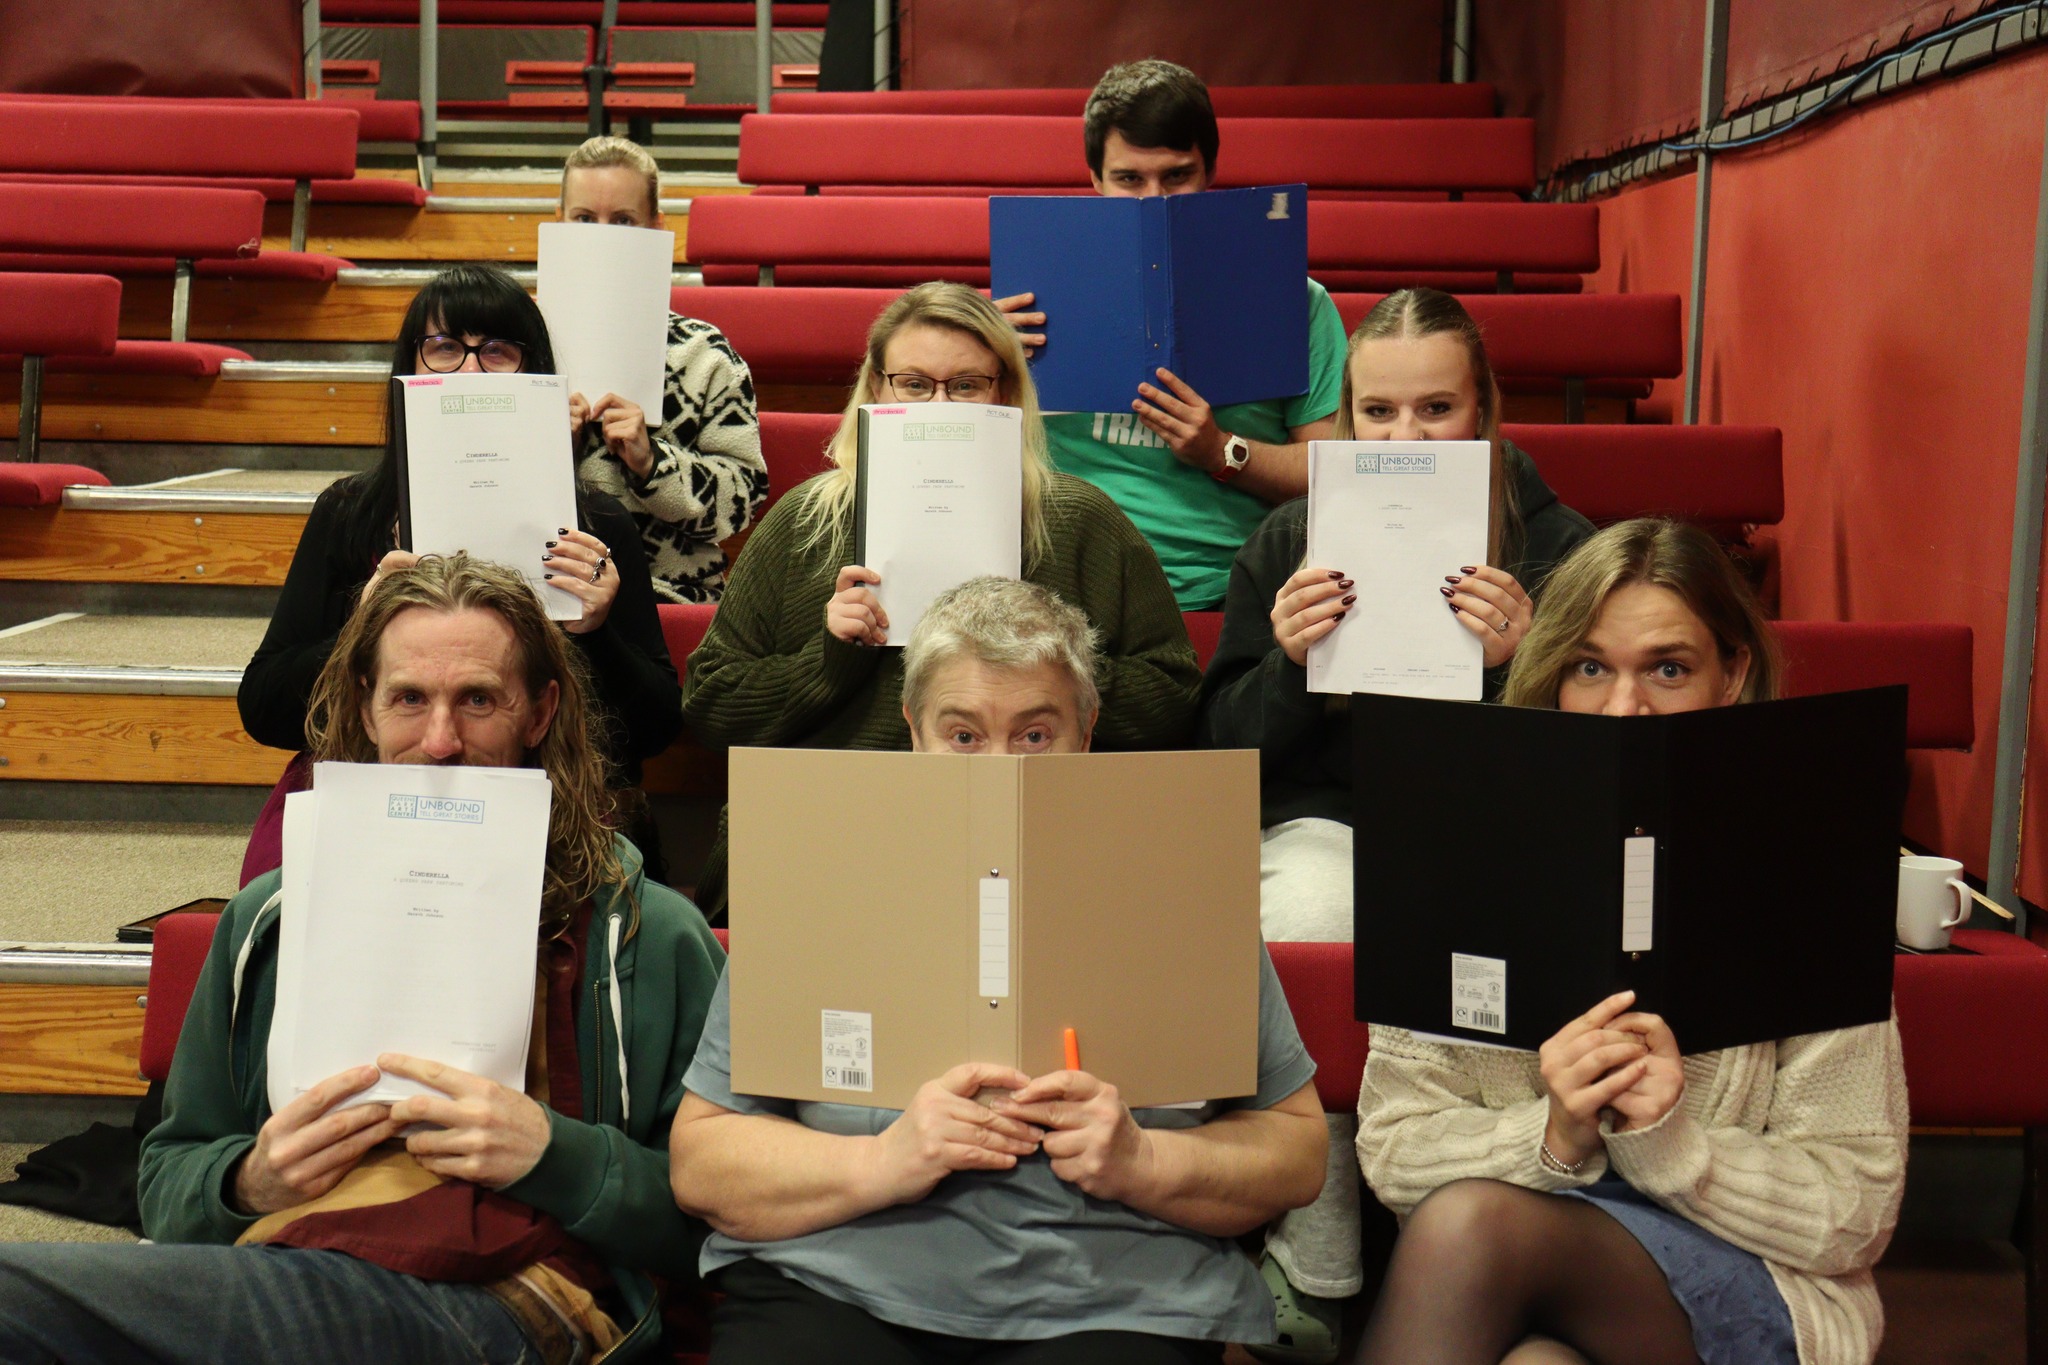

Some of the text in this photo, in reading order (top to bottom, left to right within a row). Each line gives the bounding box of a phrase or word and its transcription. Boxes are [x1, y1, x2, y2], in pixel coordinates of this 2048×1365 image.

[465, 397, 512, 405] UNBOUND
[926, 425, 972, 434] UNBOUND
[1092, 412, 1171, 449] TRA
[1381, 456, 1433, 466] UNBOUND
[420, 800, 481, 814] UNBOUND
[454, 813, 480, 821] STORIES
[409, 870, 450, 879] CINDERELLA
